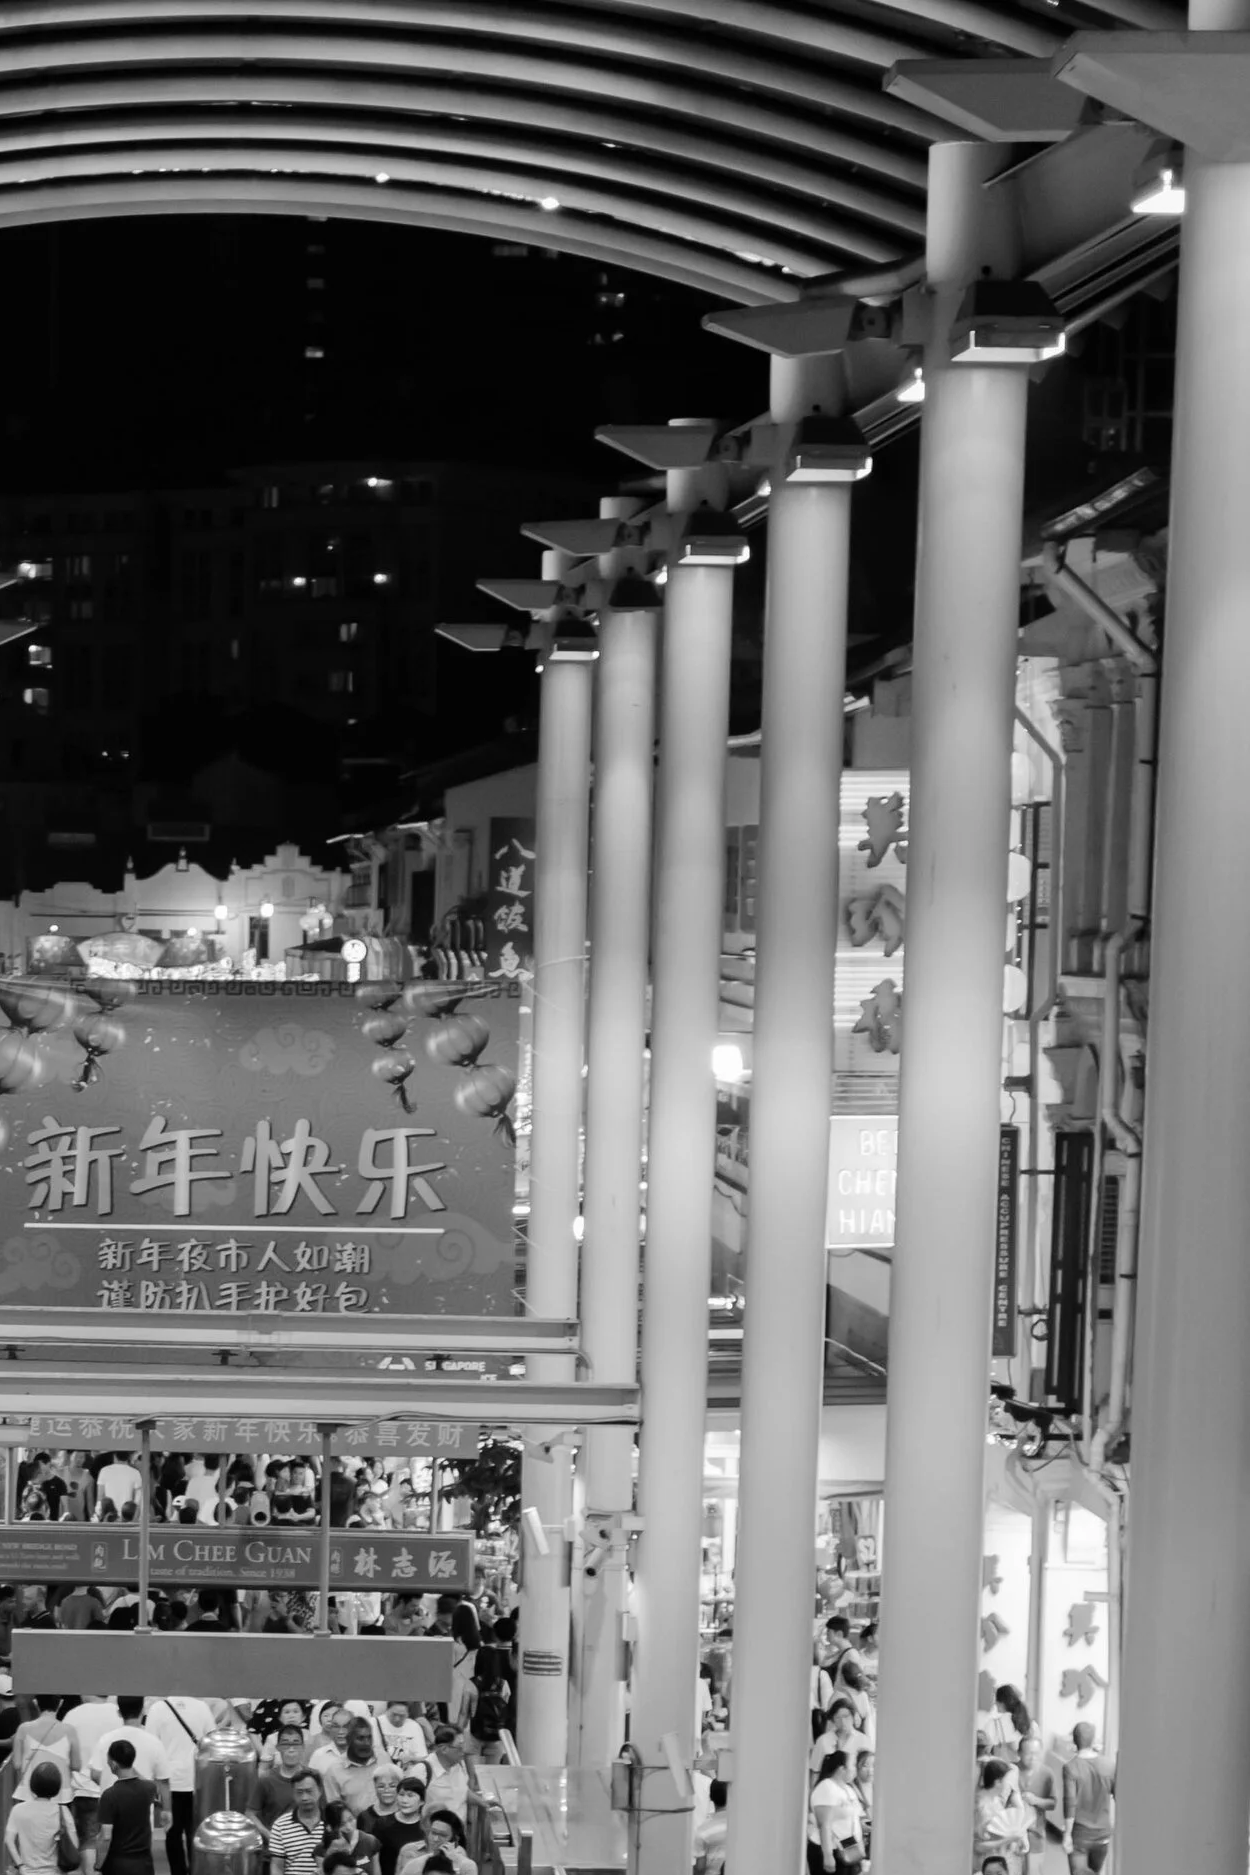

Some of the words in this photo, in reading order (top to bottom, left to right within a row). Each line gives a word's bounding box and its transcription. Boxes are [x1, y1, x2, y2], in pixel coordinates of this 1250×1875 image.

[859, 1129, 898, 1156] BE
[24, 1115, 448, 1218] 新年快乐
[97, 1236, 371, 1275] 新年夜市人如潮
[424, 1360, 486, 1372] SIGAPORE
[122, 1538, 165, 1561] LM
[173, 1539, 237, 1563] CHEE
[245, 1541, 312, 1564] GUAN
[353, 1547, 458, 1578] 林志源
